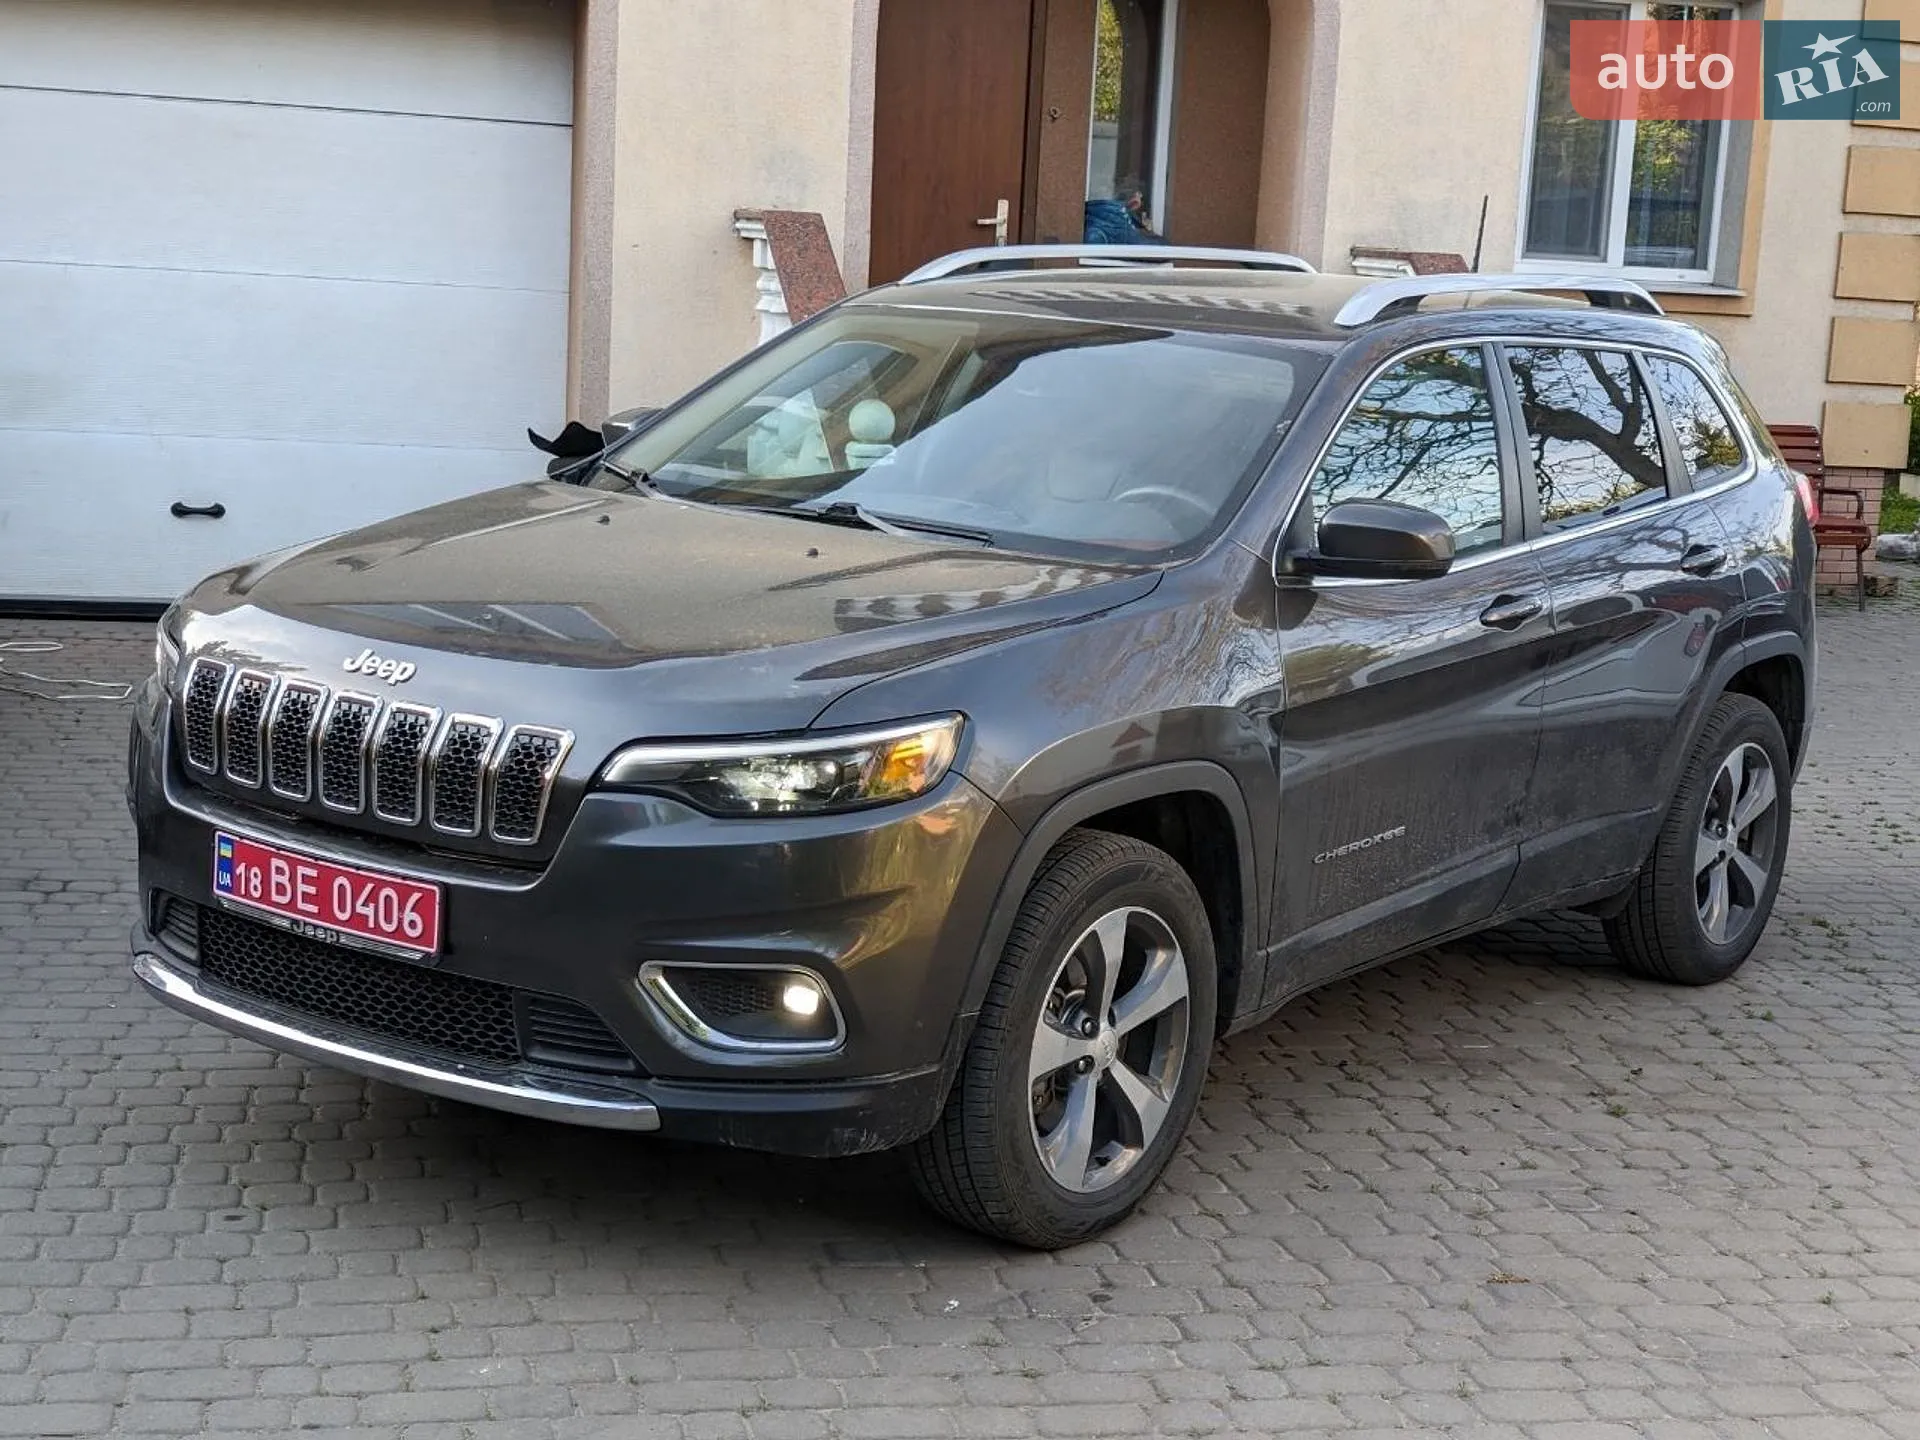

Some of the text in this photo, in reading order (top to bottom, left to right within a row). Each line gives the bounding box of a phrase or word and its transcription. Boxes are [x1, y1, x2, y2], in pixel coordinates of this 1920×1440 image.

[343, 648, 417, 686] Jeep
[1313, 826, 1406, 864] CHEROKEE
[219, 870, 233, 888] UA
[235, 857, 424, 939] 18 BE 0406
[292, 920, 338, 944] Jeep
